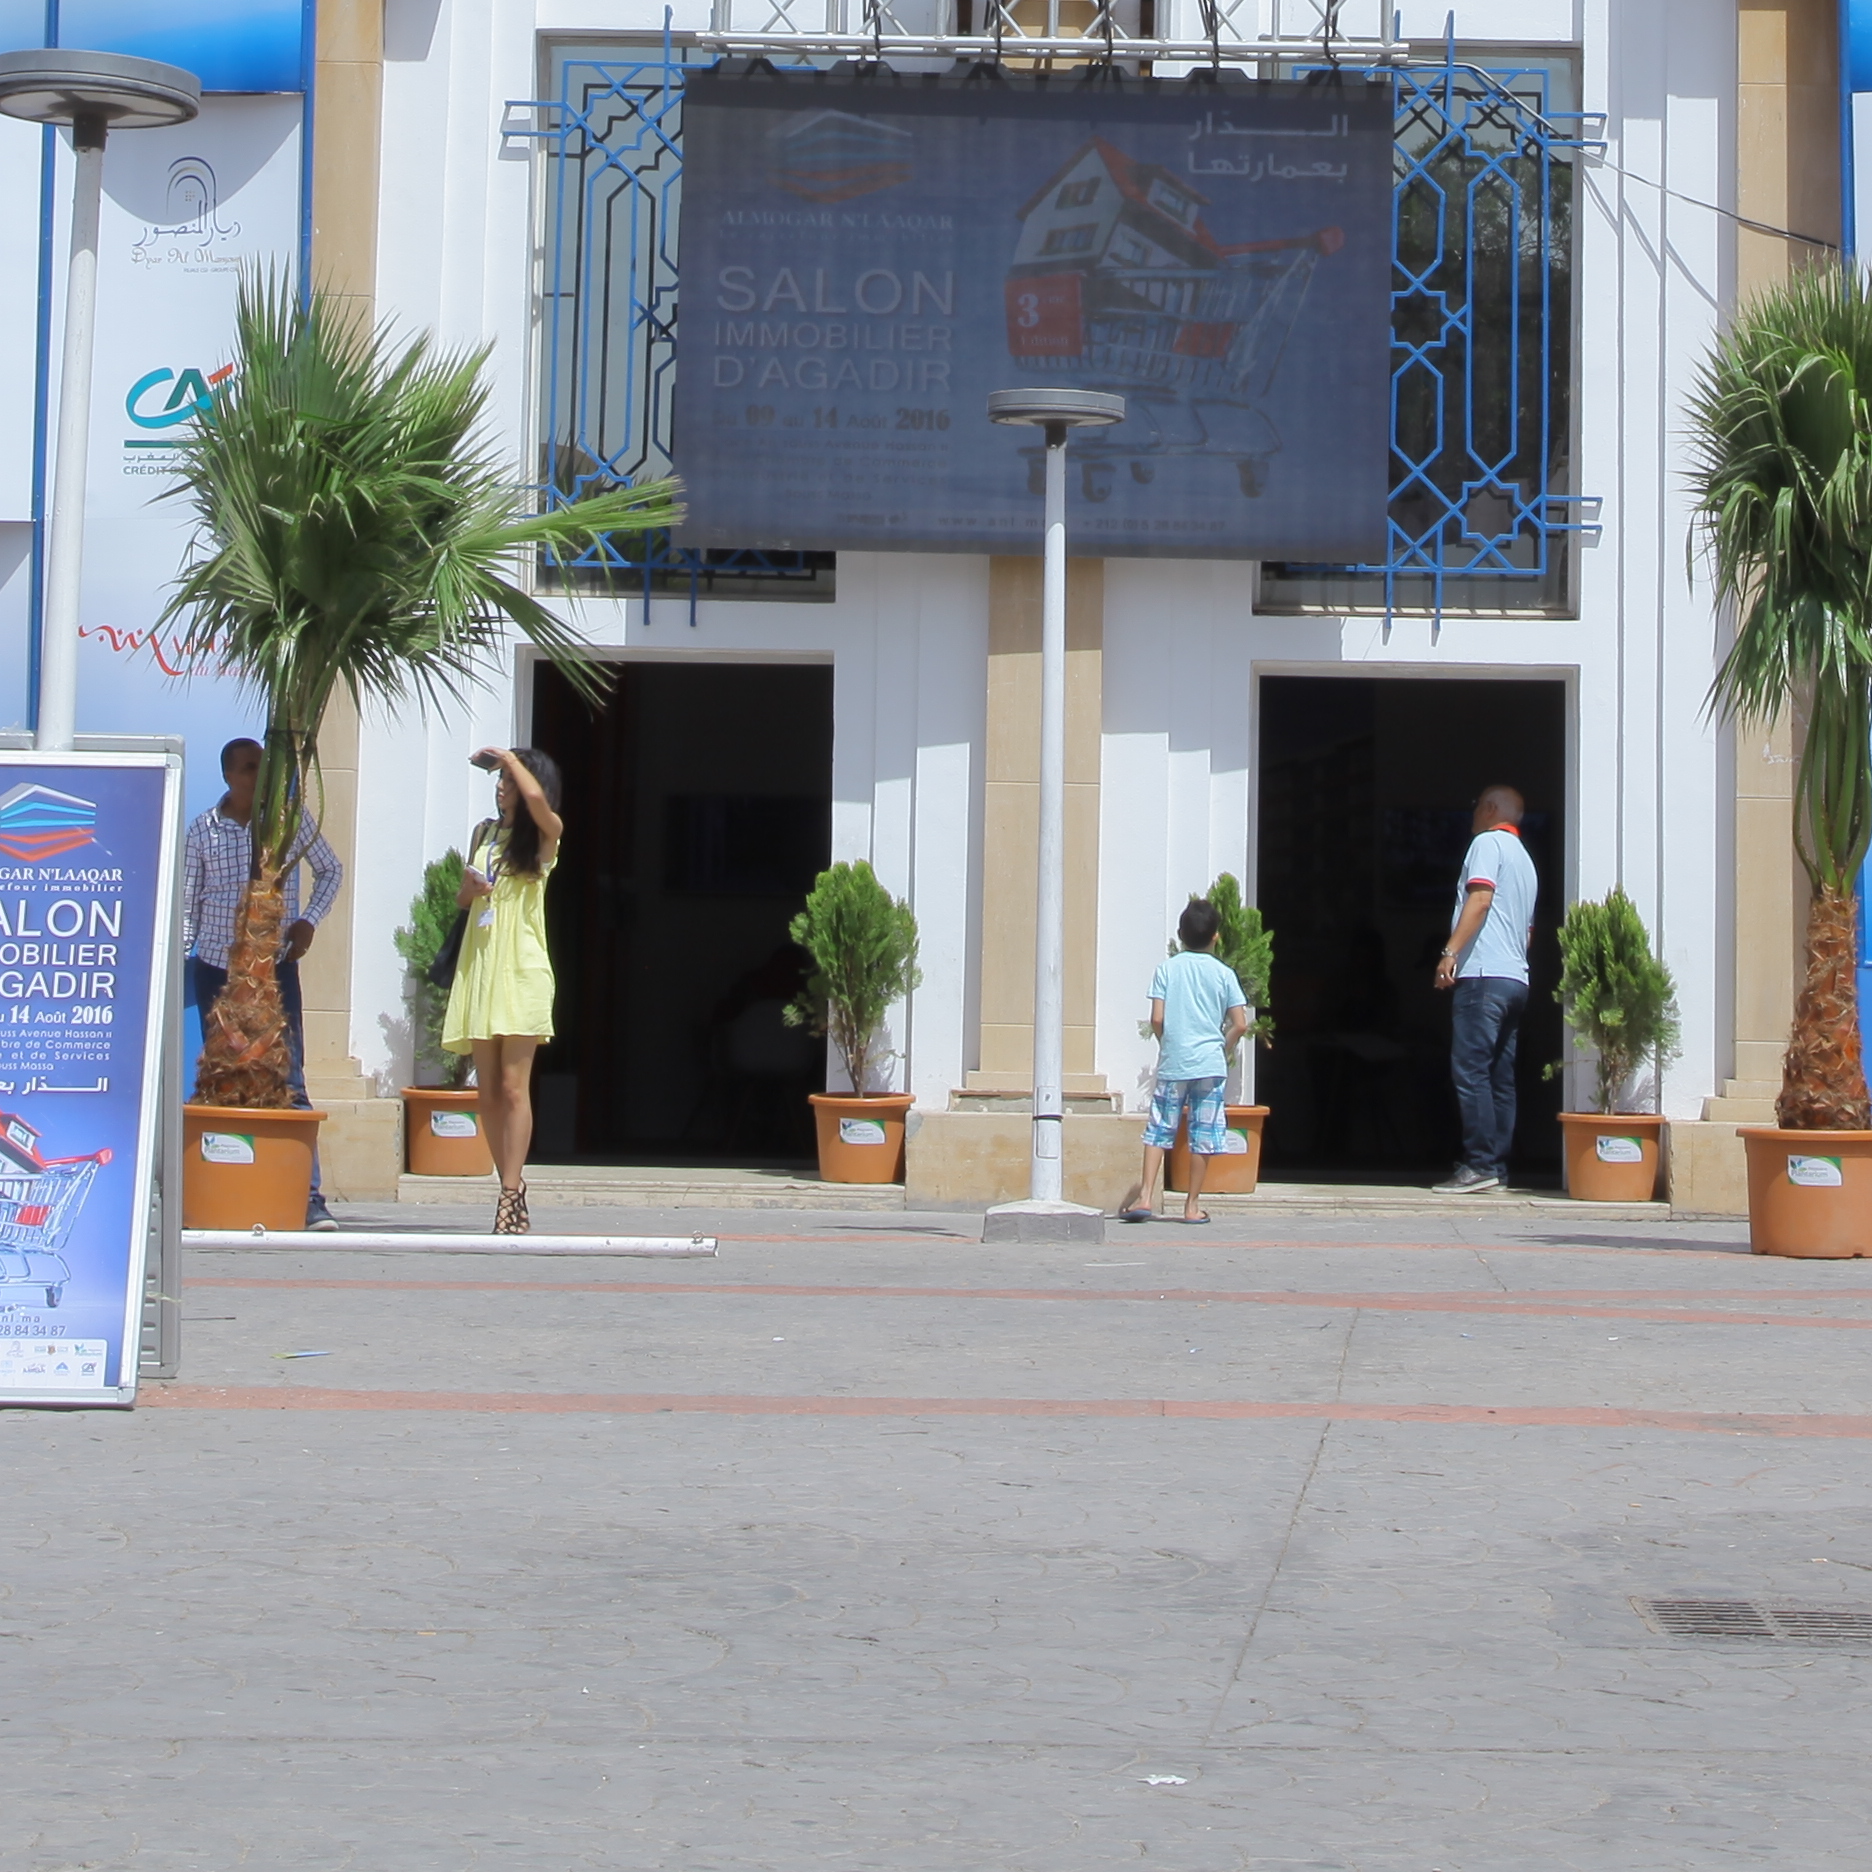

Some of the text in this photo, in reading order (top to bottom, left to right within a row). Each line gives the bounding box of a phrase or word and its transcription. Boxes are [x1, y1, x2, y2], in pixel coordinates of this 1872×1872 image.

[717, 266, 953, 315] SALON
[715, 321, 952, 351] IMMOBILIER
[713, 355, 951, 392] D'AGADIR
[38, 868, 123, 883] N'LAAQAR
[10, 1005, 29, 1023] 14
[34, 1010, 67, 1024] Août
[71, 1005, 113, 1025] 2016
[11, 1050, 24, 1060] et
[30, 1050, 46, 1060] de
[54, 1050, 110, 1061] Services
[20, 1061, 54, 1071] Massa
